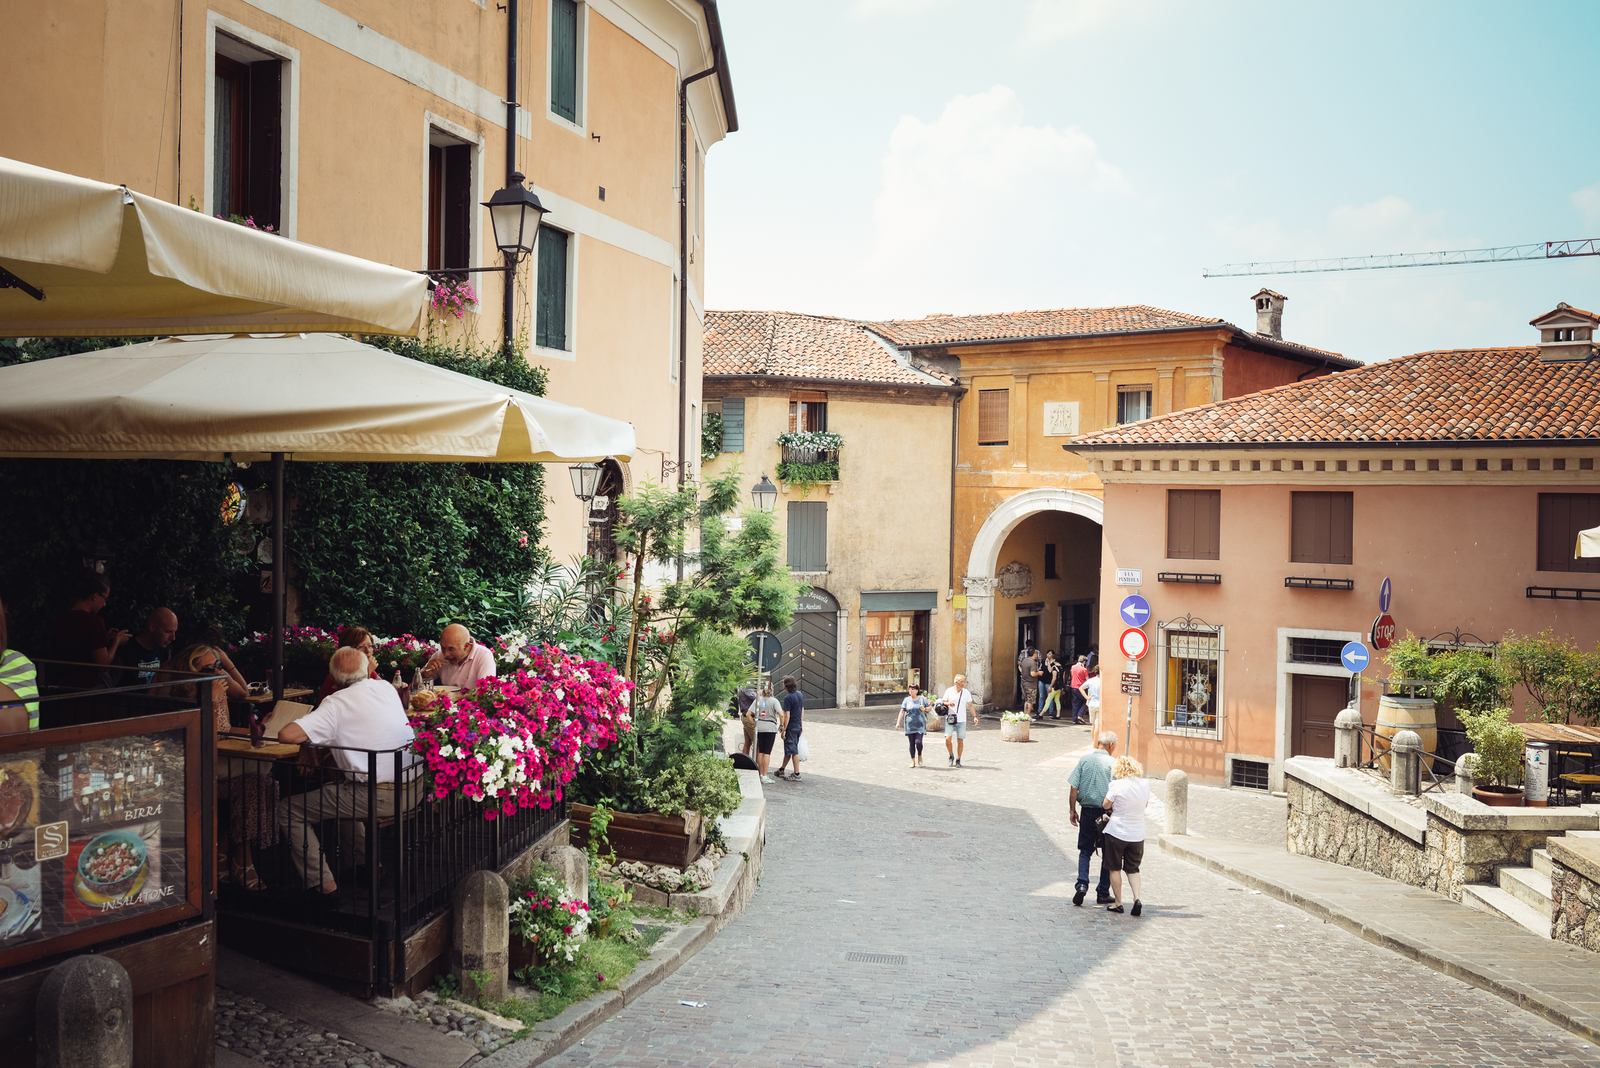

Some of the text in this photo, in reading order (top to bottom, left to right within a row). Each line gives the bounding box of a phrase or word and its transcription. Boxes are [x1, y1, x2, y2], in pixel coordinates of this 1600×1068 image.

[1376, 625, 1395, 639] STOP
[124, 804, 163, 821] BIRRA
[101, 885, 175, 912] INSALATONE
